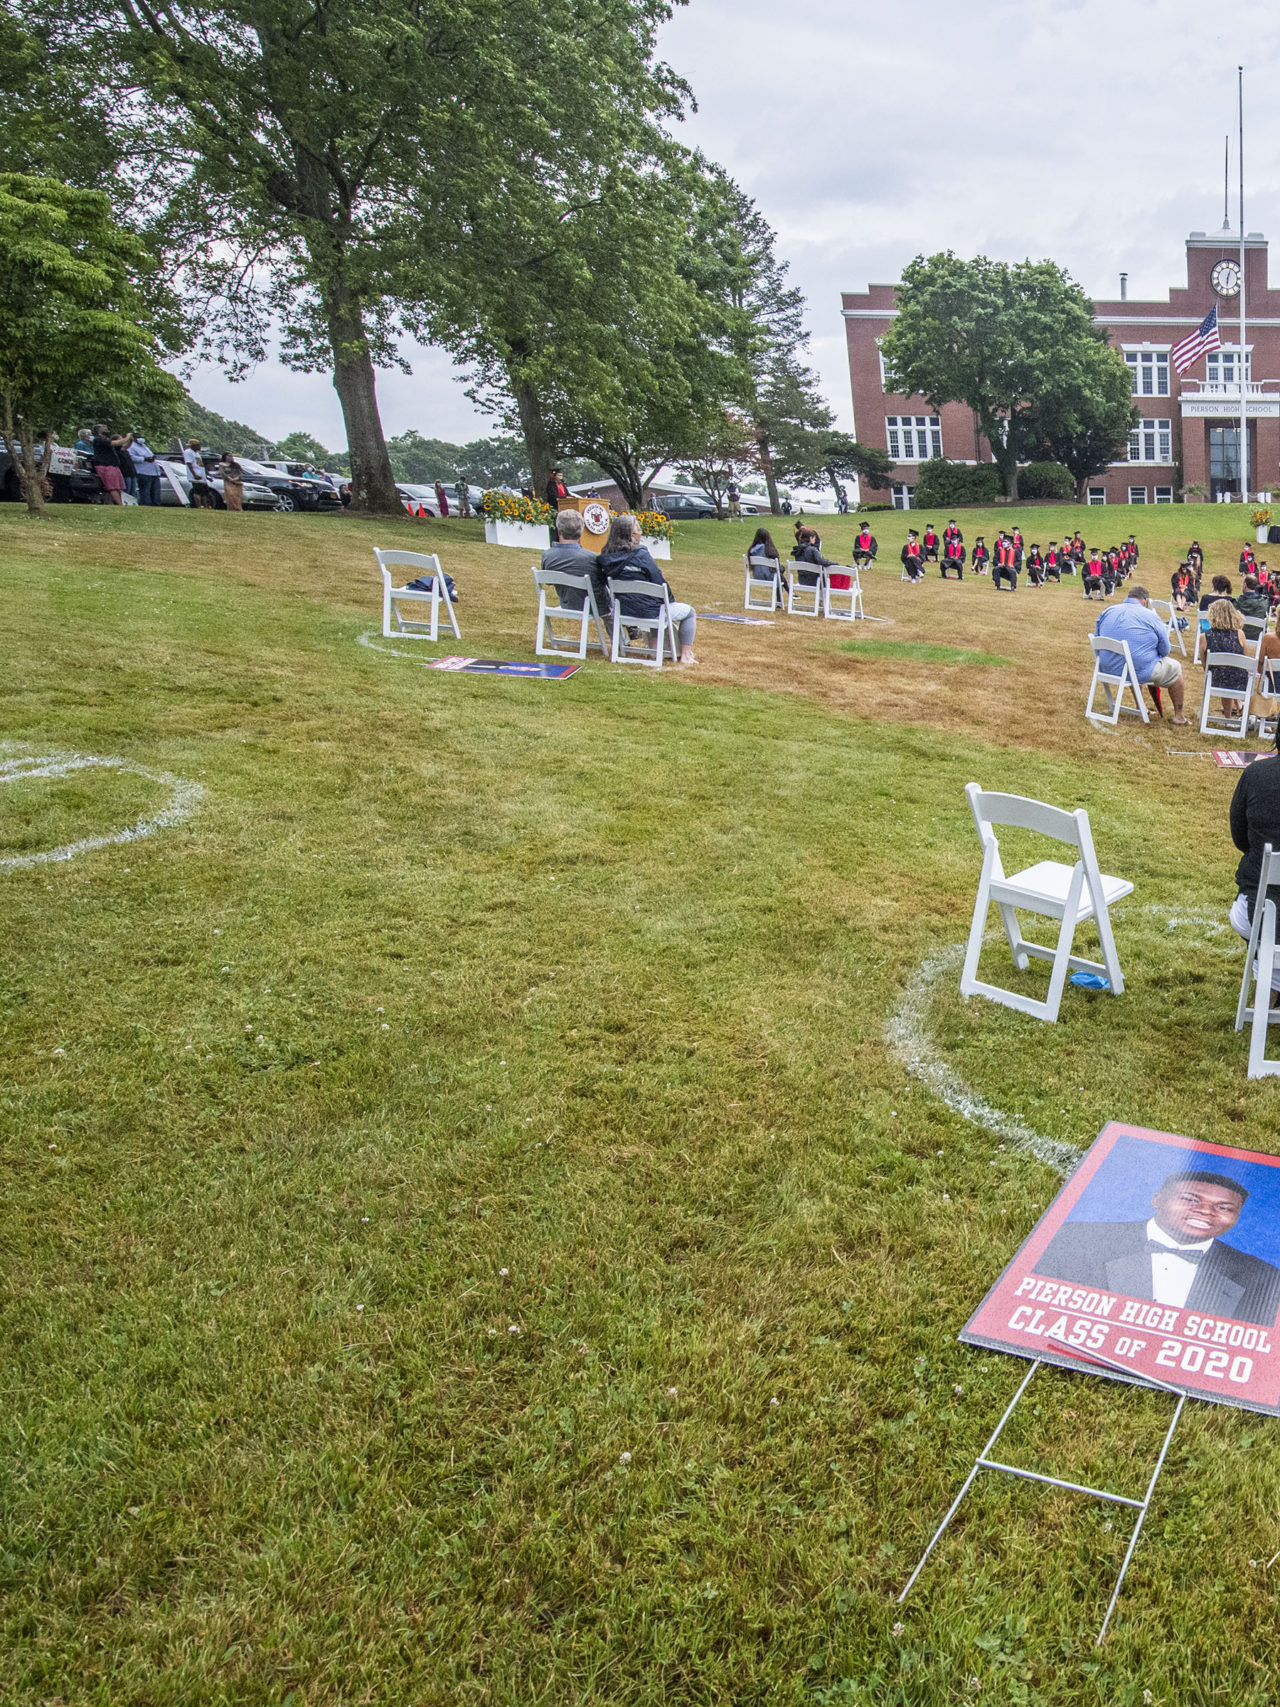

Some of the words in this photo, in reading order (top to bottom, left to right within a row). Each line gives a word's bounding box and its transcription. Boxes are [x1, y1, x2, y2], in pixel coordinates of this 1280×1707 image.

[1190, 405, 1219, 413] PIERSON
[1223, 405, 1240, 413] HIGH
[1007, 1305, 1110, 1349] CLASS
[1114, 1336, 1146, 1359] OF
[1155, 1340, 1254, 1384] 2020
[1014, 1277, 1118, 1317] PIERSON
[1119, 1301, 1180, 1332] HIGH
[1183, 1316, 1272, 1354] SCHOOL
